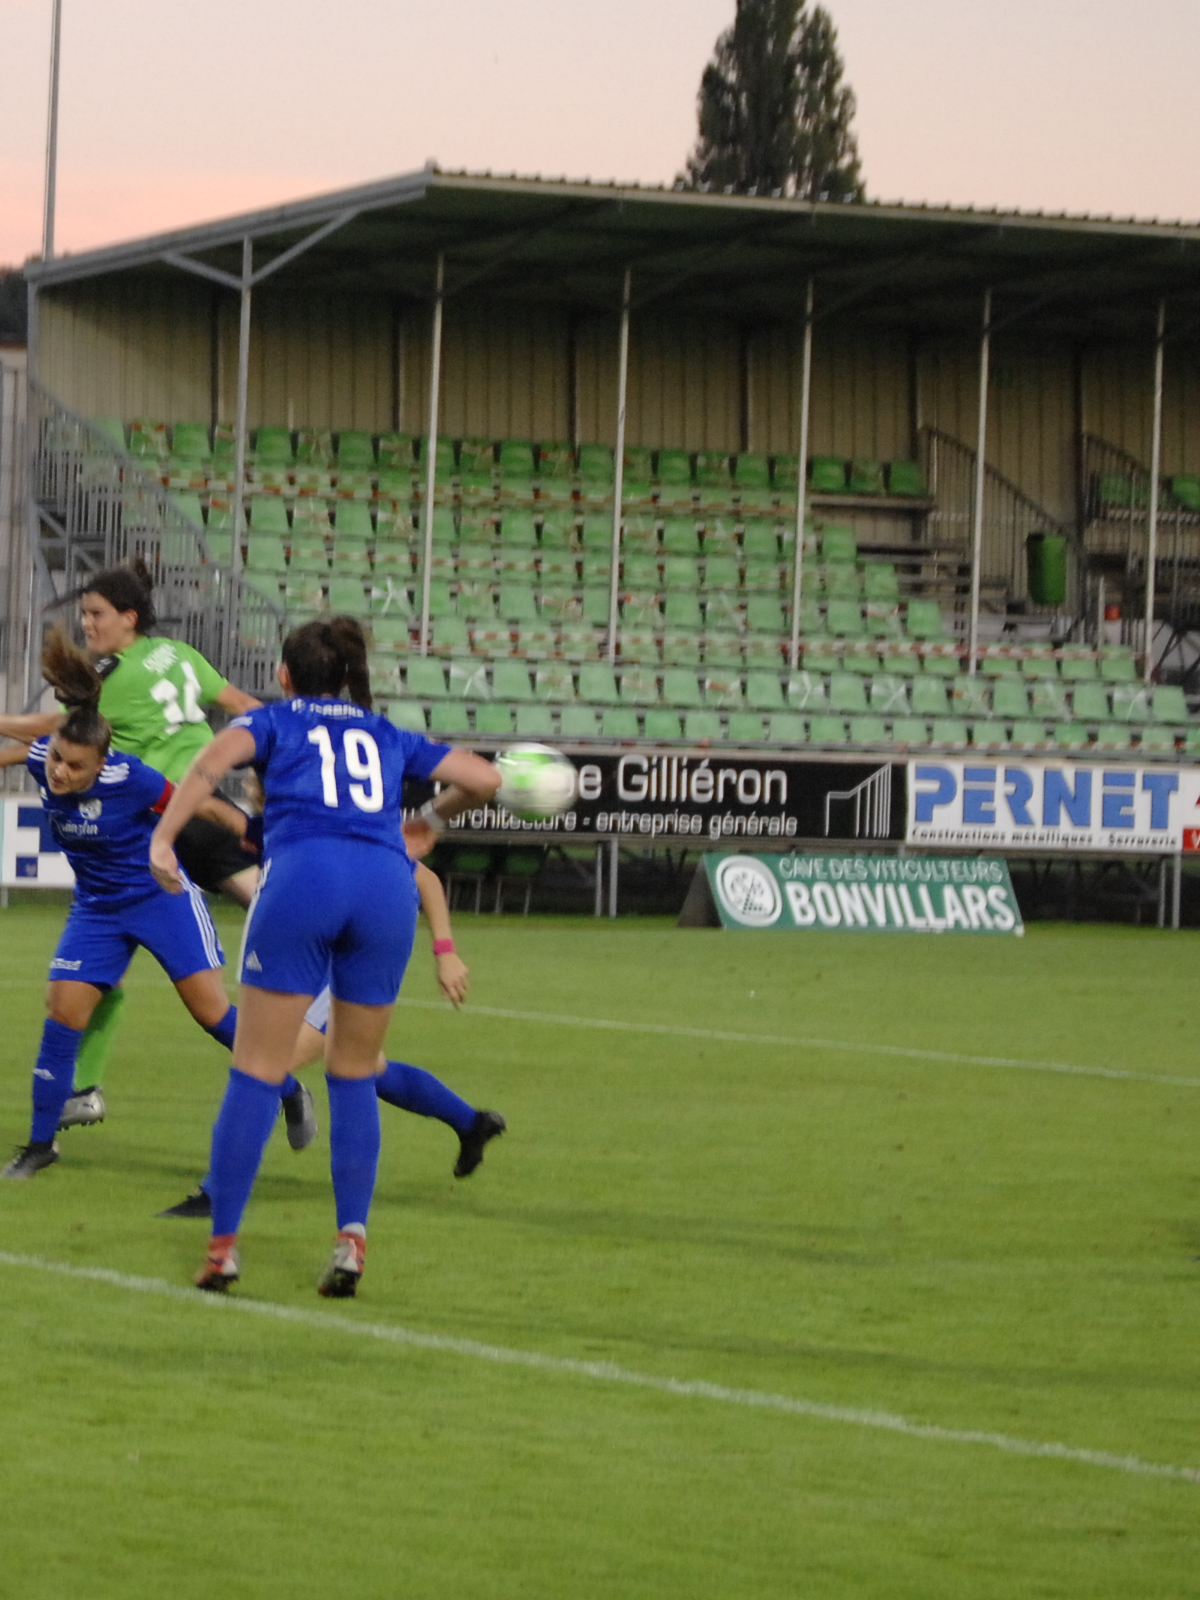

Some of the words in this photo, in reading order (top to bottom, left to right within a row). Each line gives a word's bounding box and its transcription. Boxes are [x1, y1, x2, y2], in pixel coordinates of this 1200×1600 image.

[308, 725, 384, 813] 19
[617, 754, 787, 804] Gilliéron
[915, 765, 1179, 829] PERNET
[596, 809, 702, 838] entreprise
[710, 811, 798, 840] générale
[779, 857, 827, 879] CAVE
[829, 858, 868, 880] DES
[868, 859, 1003, 883] VITICULTEURS
[785, 881, 1016, 930] BONVILLARS
